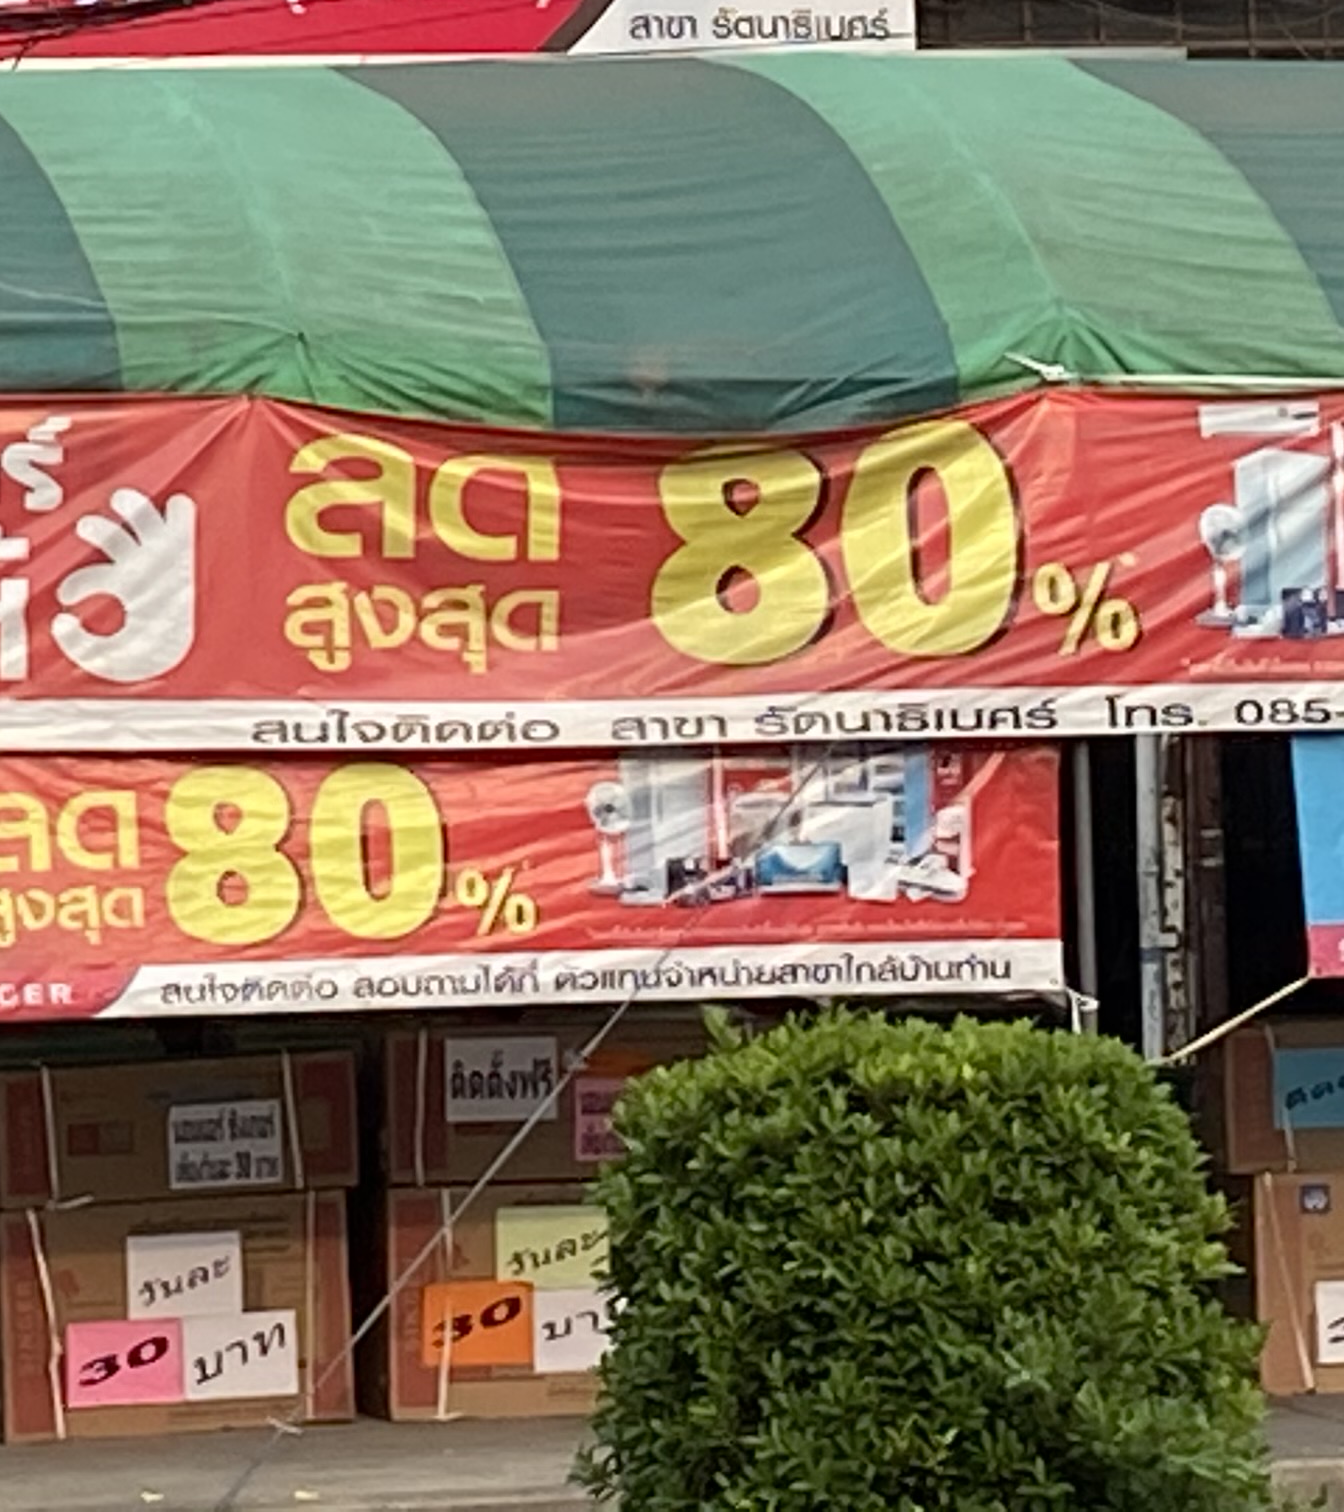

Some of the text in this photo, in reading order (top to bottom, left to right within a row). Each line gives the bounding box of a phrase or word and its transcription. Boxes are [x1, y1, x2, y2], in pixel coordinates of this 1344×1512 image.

[628, 14, 698, 39] สาขา
[284, 432, 561, 564] ลด
[283, 581, 561, 674] สูงสุด
[251, 708, 561, 744] สนใจติดต่อ
[611, 713, 728, 742] สาขา
[755, 697, 1059, 738] รัตนาธิเบศร์
[159, 972, 339, 1006] สนใจติดต่อ
[138, 1255, 231, 1307] วันละ
[432, 1295, 523, 1349] 30
[78, 1321, 286, 1387] 30 บาท
